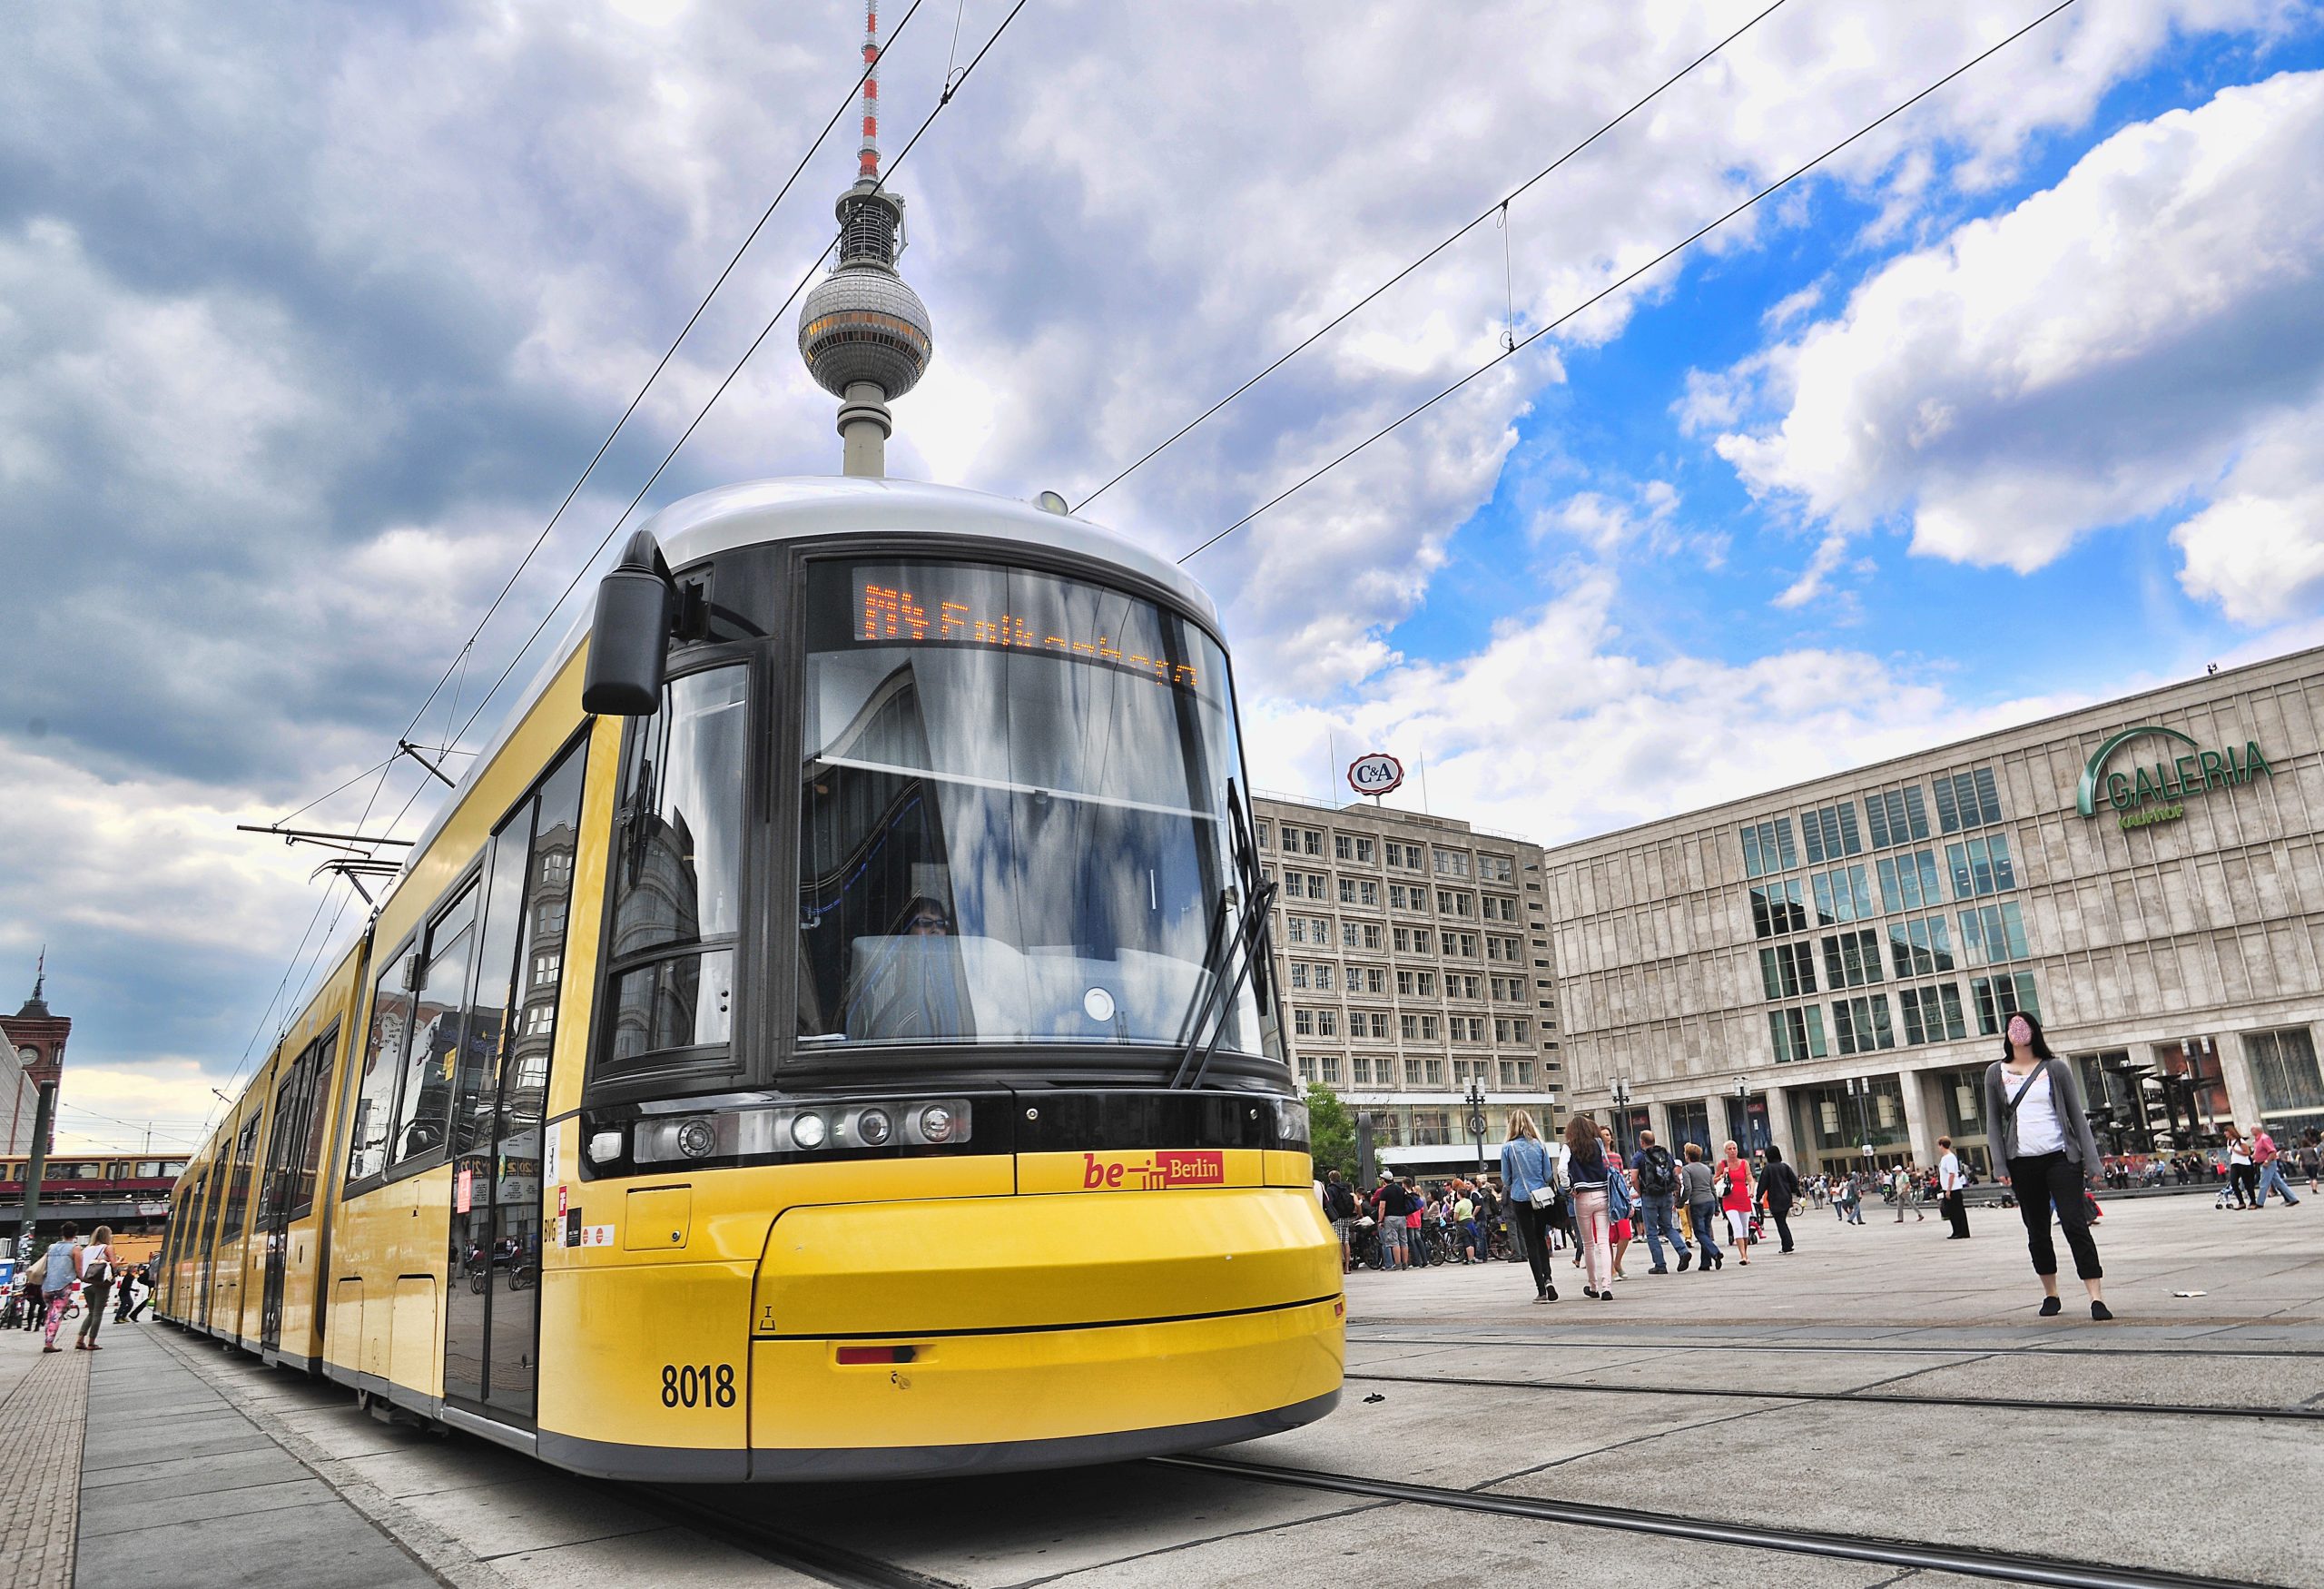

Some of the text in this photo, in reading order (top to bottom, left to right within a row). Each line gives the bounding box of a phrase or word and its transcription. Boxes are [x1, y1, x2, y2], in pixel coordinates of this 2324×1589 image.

[1356, 763, 1393, 783] C&A
[2105, 740, 2274, 812] GALERIA
[1083, 1152, 1124, 1189] be
[1169, 1158, 1219, 1179] Berlin
[544, 1218, 556, 1243] BVG
[661, 1363, 737, 1409] 8018
